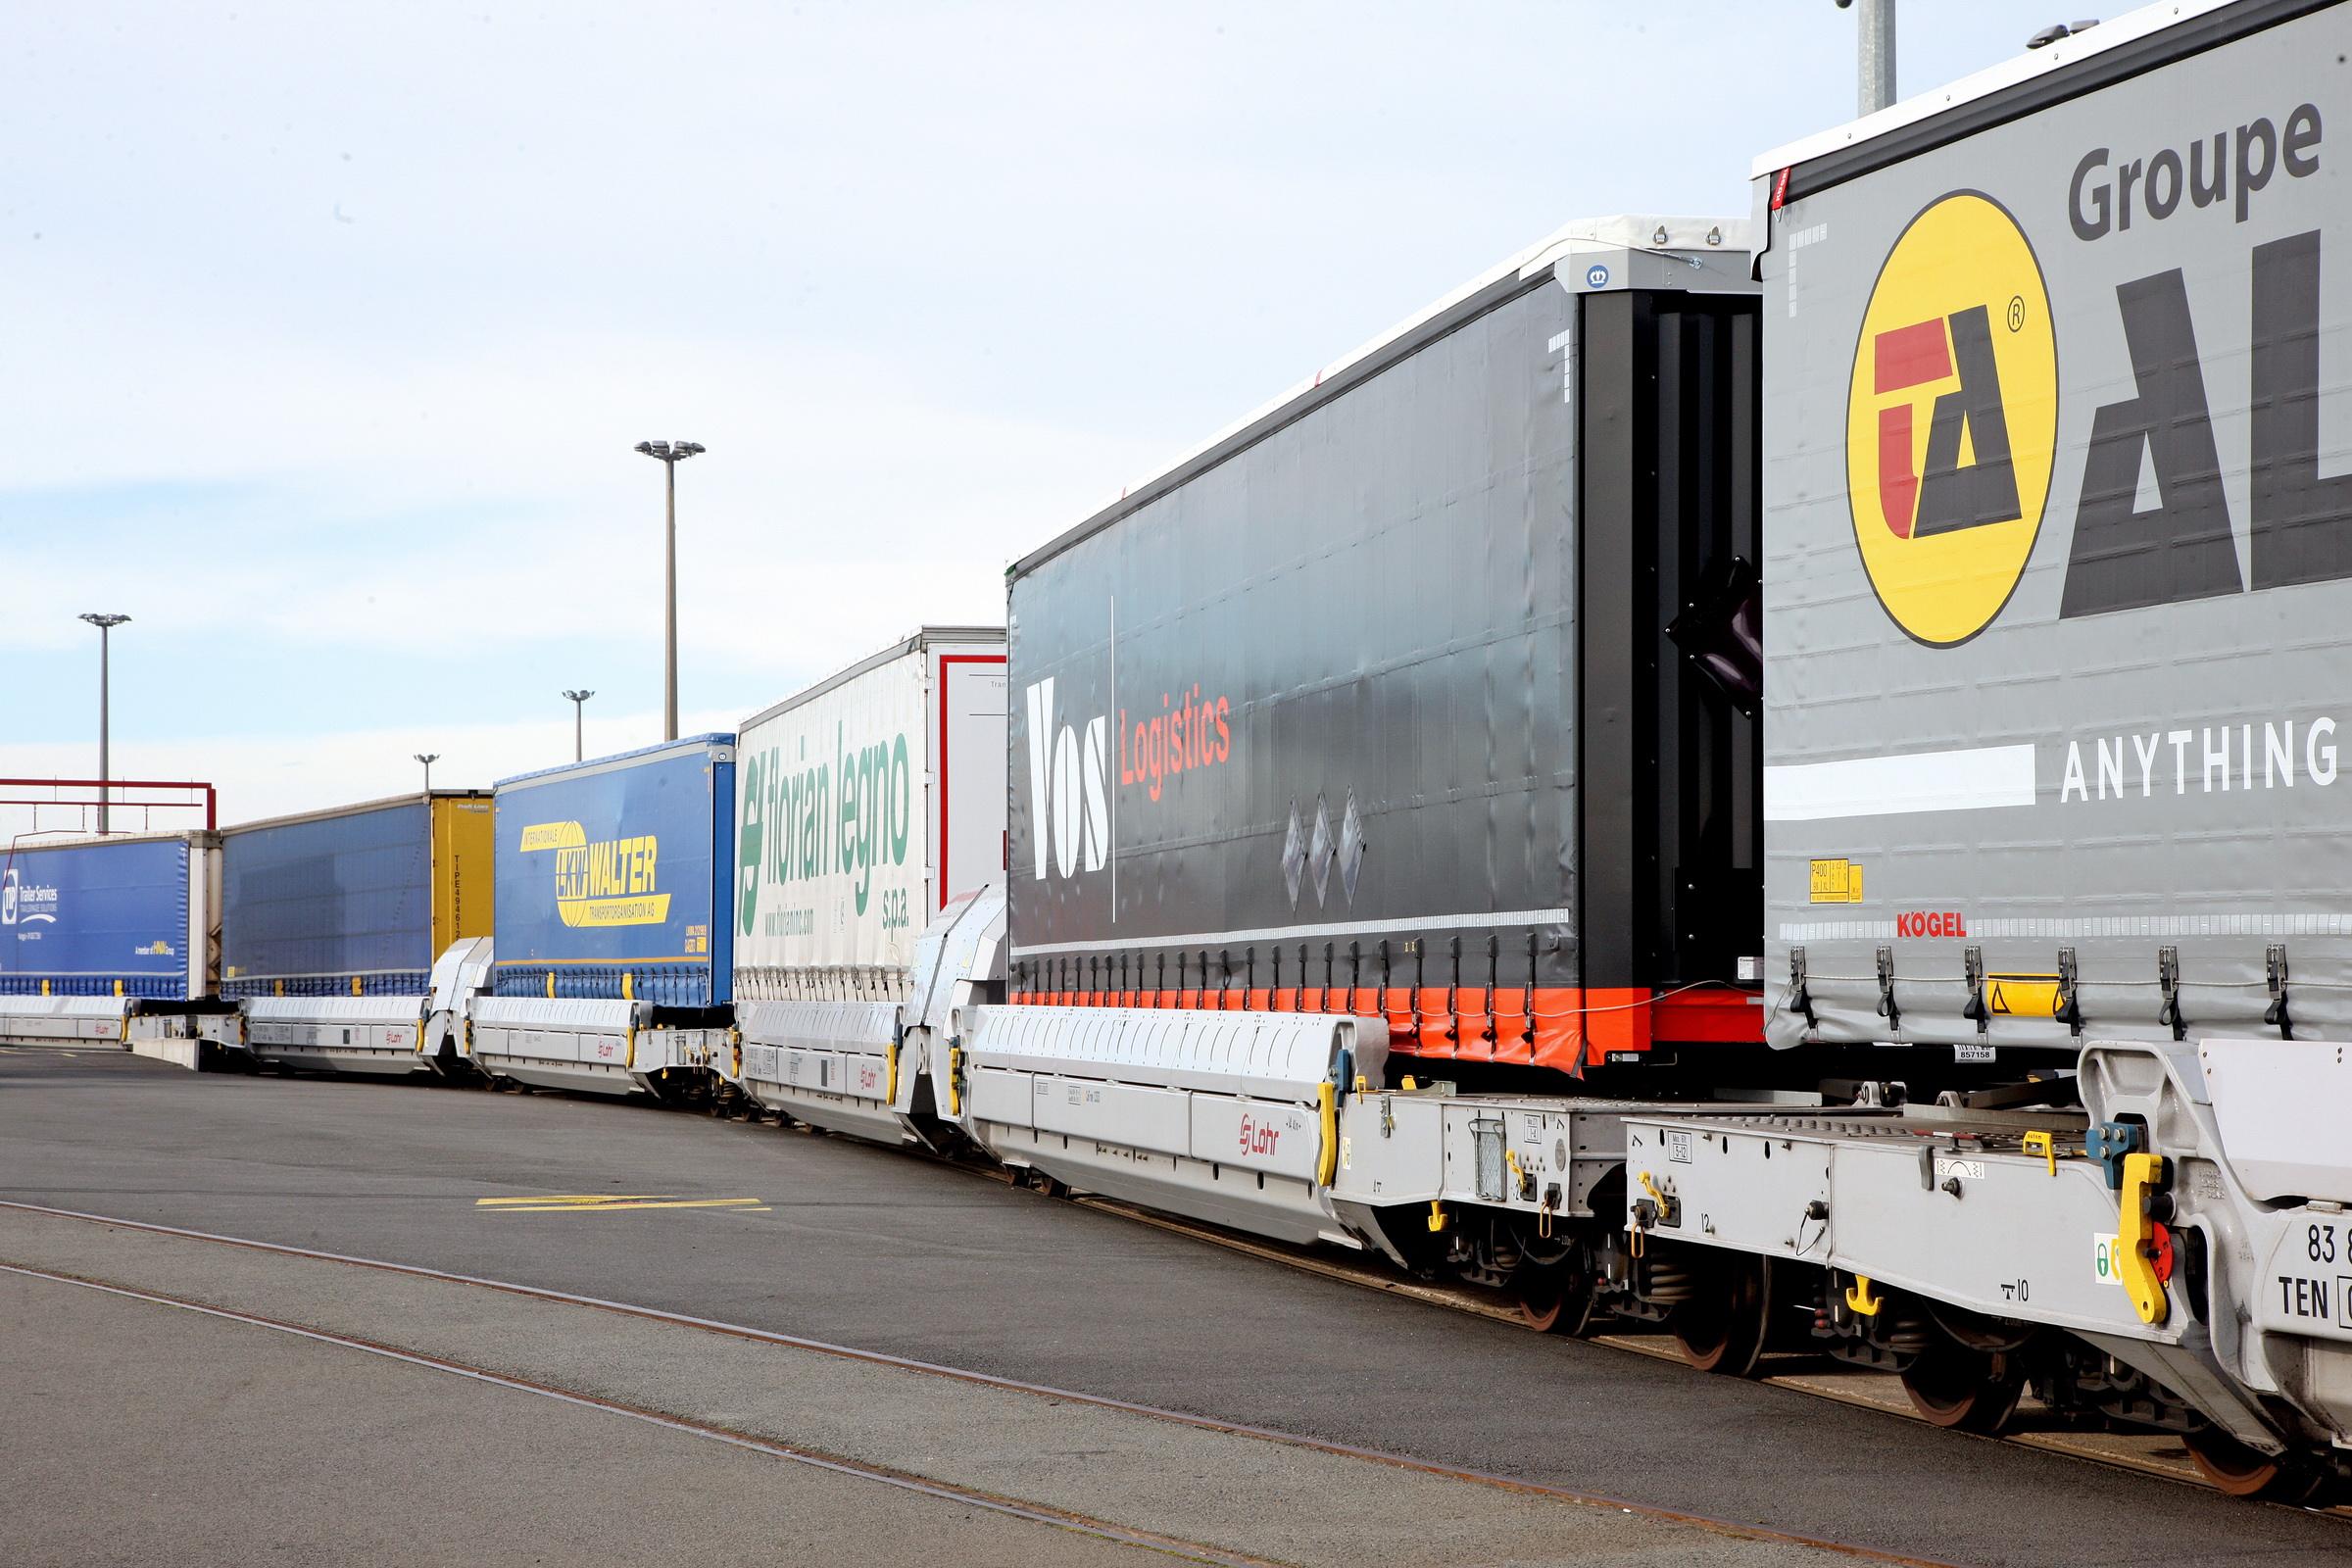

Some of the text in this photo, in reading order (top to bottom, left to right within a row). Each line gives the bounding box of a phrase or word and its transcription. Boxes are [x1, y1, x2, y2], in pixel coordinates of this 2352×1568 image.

[2068, 102, 2323, 242] Groupe
[1026, 676, 1231, 880] Vos Logistics
[2061, 716, 2337, 804] ANYTHING
[767, 720, 909, 917] florian legno
[589, 835, 658, 896] WALTER
[1811, 863, 1828, 877] P400
[4, 886, 16, 910] TIP
[20, 884, 58, 902] Trailer Services
[589, 902, 655, 920] TRANSPORTORGANISATION AG
[882, 887, 909, 942] s.p.a.
[1896, 910, 1967, 938] KÖGEL
[1251, 1119, 1279, 1156] Lohr
[2308, 1224, 2335, 1263] 83
[2017, 1278, 2030, 1301] 10
[2278, 1276, 2328, 1319] TEN
